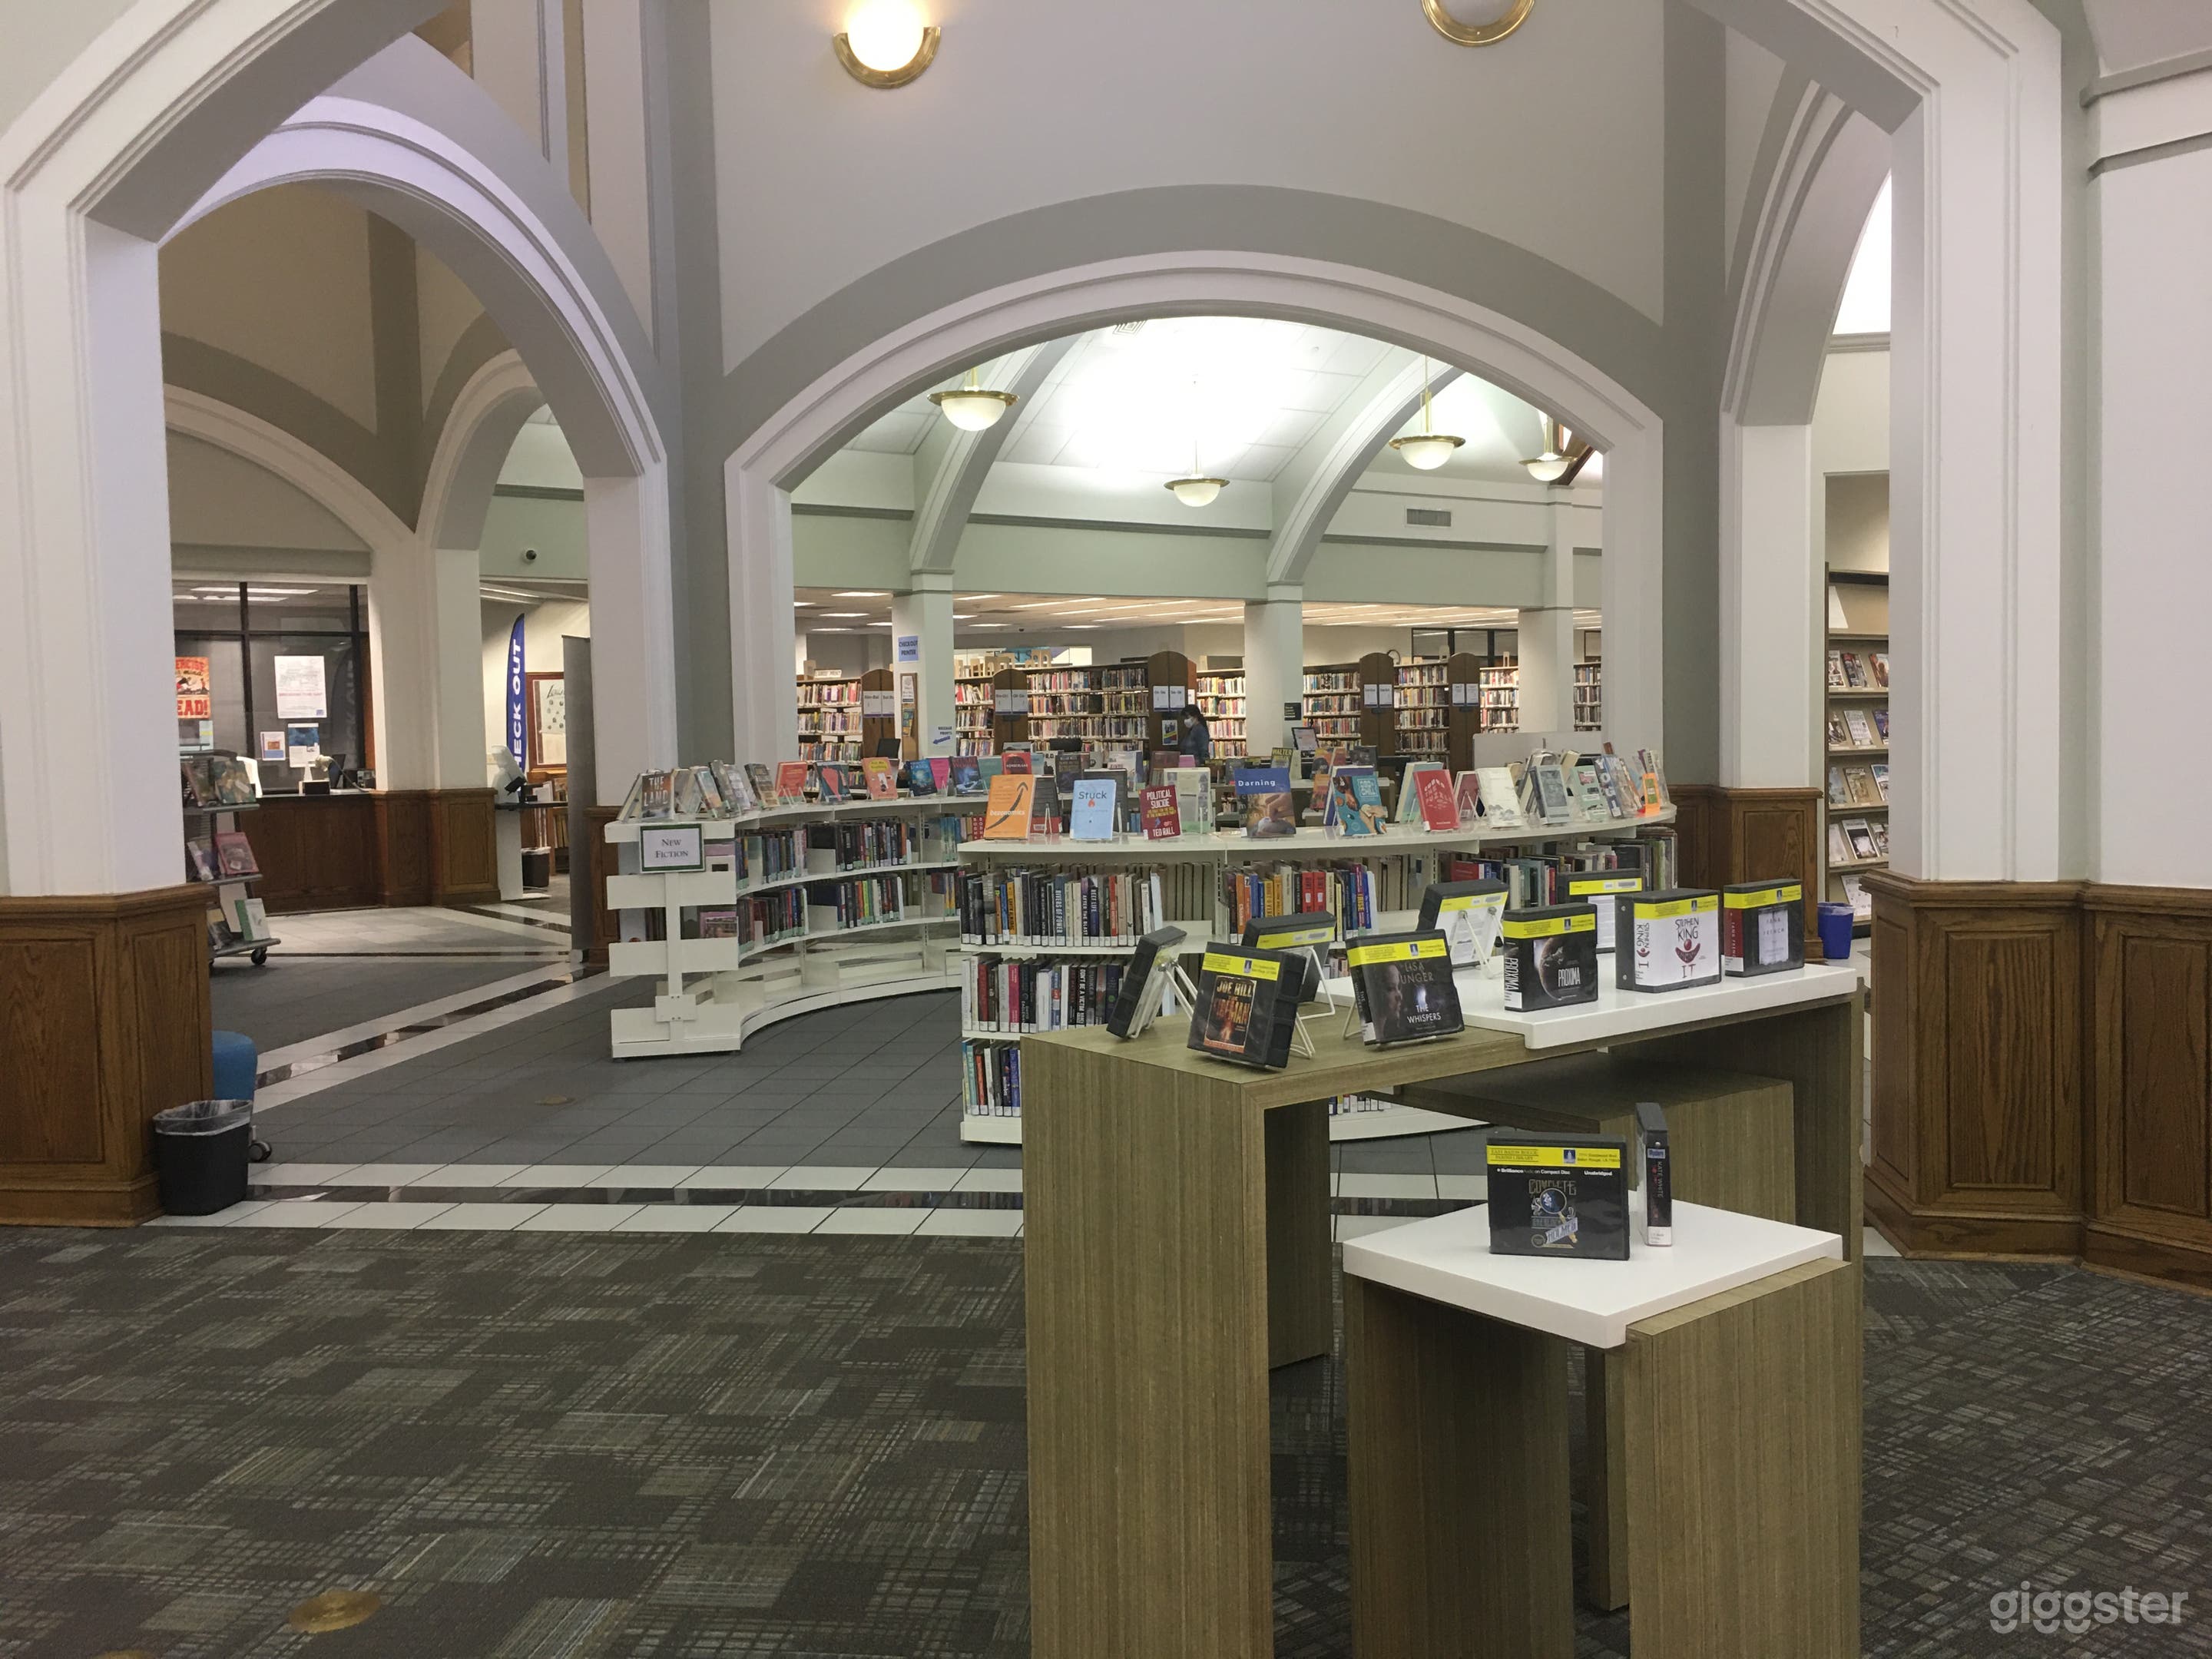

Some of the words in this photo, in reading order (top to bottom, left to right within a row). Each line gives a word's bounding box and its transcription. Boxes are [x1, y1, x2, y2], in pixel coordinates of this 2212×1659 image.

[176, 658, 204, 672] ERCISE
[512, 639, 522, 695] OUT
[177, 700, 208, 716] EAD!
[513, 702, 522, 770] HECK
[649, 776, 664, 790] THE
[644, 790, 668, 806] LAND
[1078, 790, 1108, 800] Stuck
[1146, 789, 1172, 800] POLITICAL
[1151, 798, 1171, 809] SUICIDE
[661, 838, 682, 846] NEW
[655, 850, 688, 859] FICTION
[1675, 917, 1699, 929] STEPHEN
[1677, 926, 1699, 942] KING
[1405, 962, 1426, 972] LISA
[1505, 957, 1519, 990] PROXIMA
[1682, 963, 1696, 979] IT
[1400, 972, 1435, 985] UNGER
[1558, 967, 1581, 987] PROXIMA
[1217, 981, 1233, 994] JOE
[1234, 982, 1253, 997] HILL
[1416, 1004, 1429, 1012] THE
[1407, 1012, 1442, 1024] WHISPERS
[1528, 1179, 1577, 1196] COMPLETE
